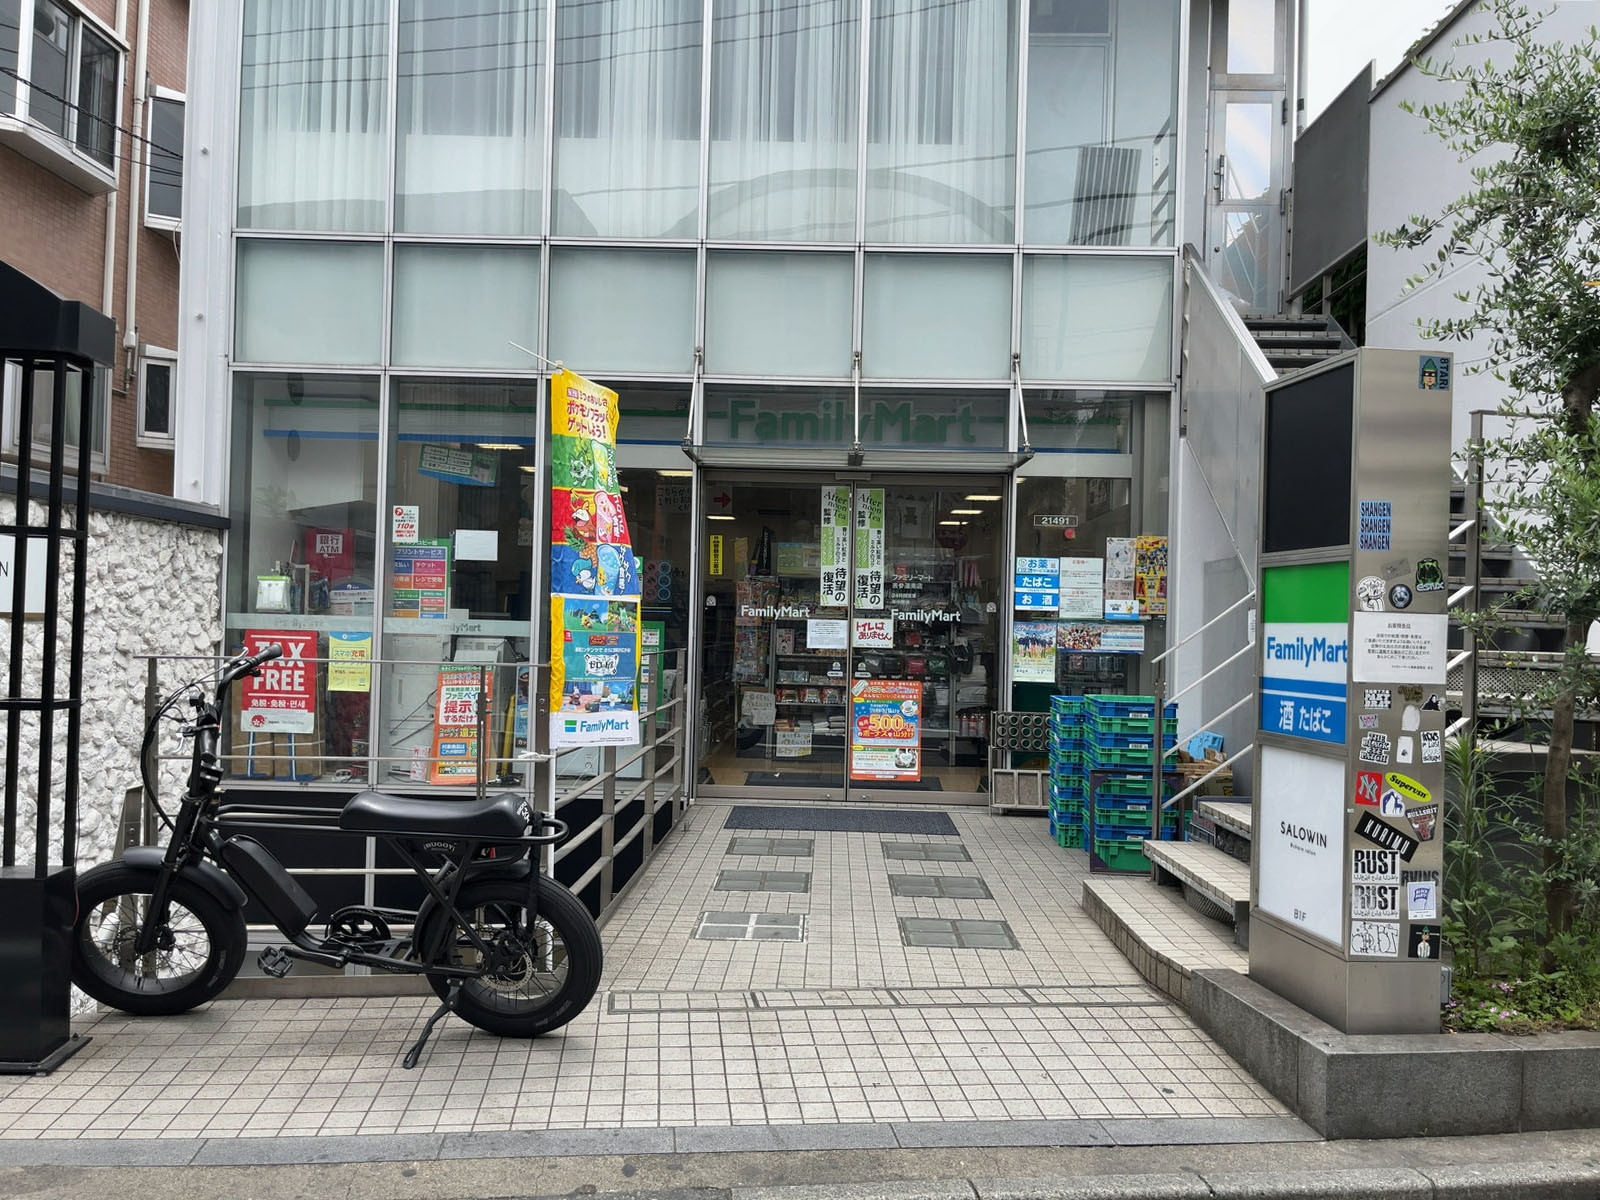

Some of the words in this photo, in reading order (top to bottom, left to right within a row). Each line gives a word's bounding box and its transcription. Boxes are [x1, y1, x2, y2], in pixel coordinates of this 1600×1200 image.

[730, 400, 976, 442] FamilyMart
[823, 491, 848, 504] After
[859, 493, 882, 507] After
[828, 500, 847, 511] noon
[862, 503, 881, 514] noon
[1360, 502, 1391, 517] SHANGEN
[833, 509, 846, 520] Tea
[868, 511, 880, 521] Tea
[1041, 517, 1070, 525] 21491
[1360, 518, 1391, 534] SHANGEN
[320, 545, 339, 553] ATM
[1359, 535, 1390, 551] SHANGEN
[823, 572, 834, 595] 復活
[835, 568, 847, 602] 待望の
[857, 575, 869, 599] 復活
[870, 570, 881, 605] 待望の
[1022, 577, 1052, 587] たばこ
[741, 605, 810, 620] FamilyMart
[891, 609, 961, 624] FamilyMart
[856, 621, 885, 631] トイレは
[858, 631, 892, 640] ありません
[1267, 636, 1348, 668] FamilyMart
[253, 668, 305, 691] FREE
[444, 701, 472, 714] 提示
[1279, 700, 1295, 731] 酒
[1299, 705, 1331, 734] たばこ
[580, 719, 629, 733] FamilyMart
[1390, 775, 1427, 799] Supervsn
[1407, 807, 1438, 818] BULLSHIT
[1280, 821, 1327, 848] SALOWIN
[1364, 819, 1410, 855] KURIMU
[1354, 850, 1399, 874] RUST
[1354, 885, 1399, 910] RUST
[1294, 908, 1307, 921] B1F
